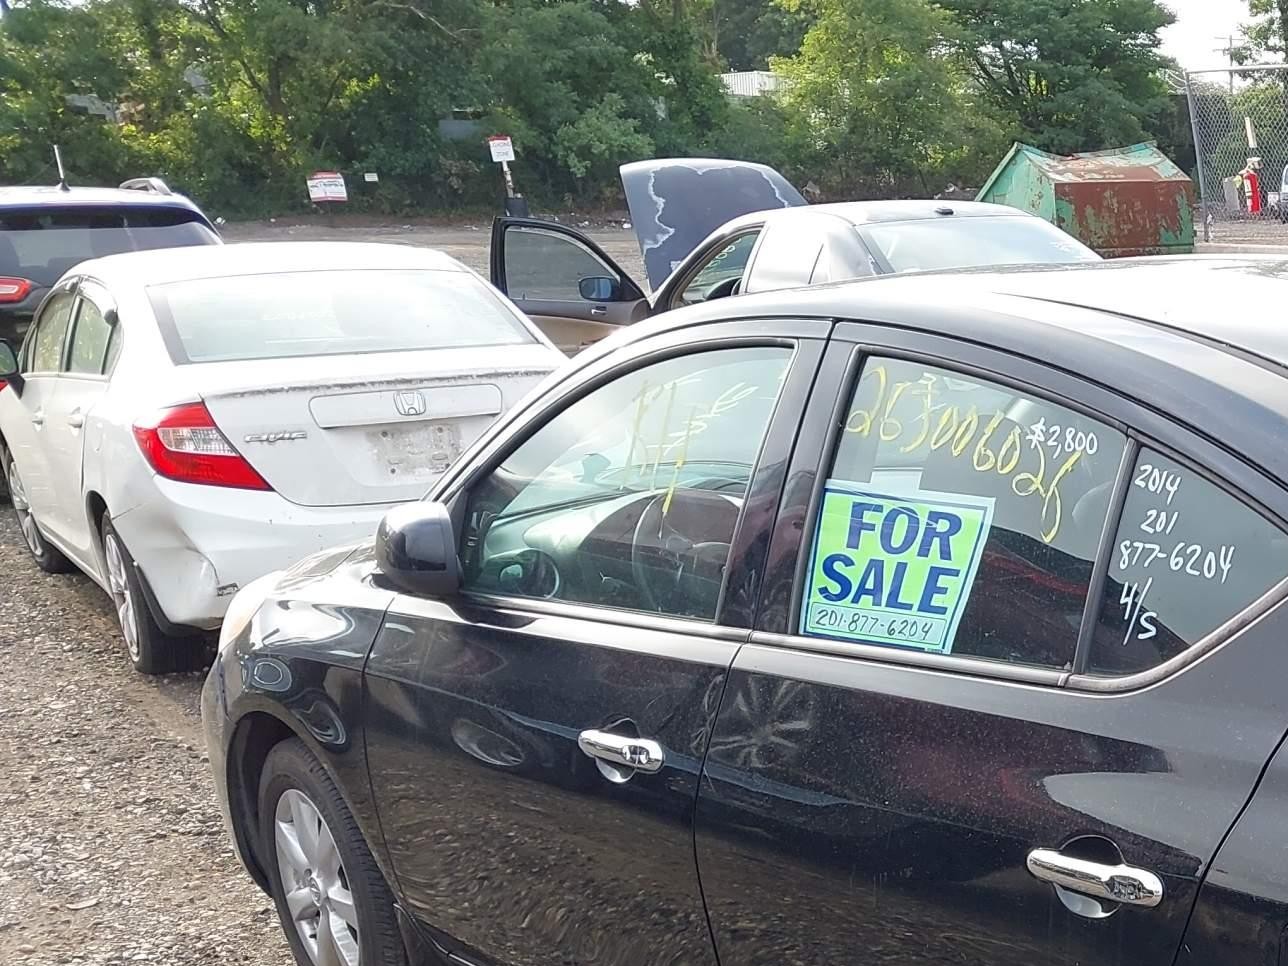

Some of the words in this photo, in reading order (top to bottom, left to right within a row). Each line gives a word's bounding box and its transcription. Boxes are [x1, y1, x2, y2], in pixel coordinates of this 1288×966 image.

[1025, 416, 1099, 460] $2,800
[1134, 463, 1182, 506] 2014
[846, 501, 963, 562] FOR
[1140, 508, 1179, 536] 201
[817, 553, 961, 616] SALE
[1119, 539, 1236, 585] 877-6204
